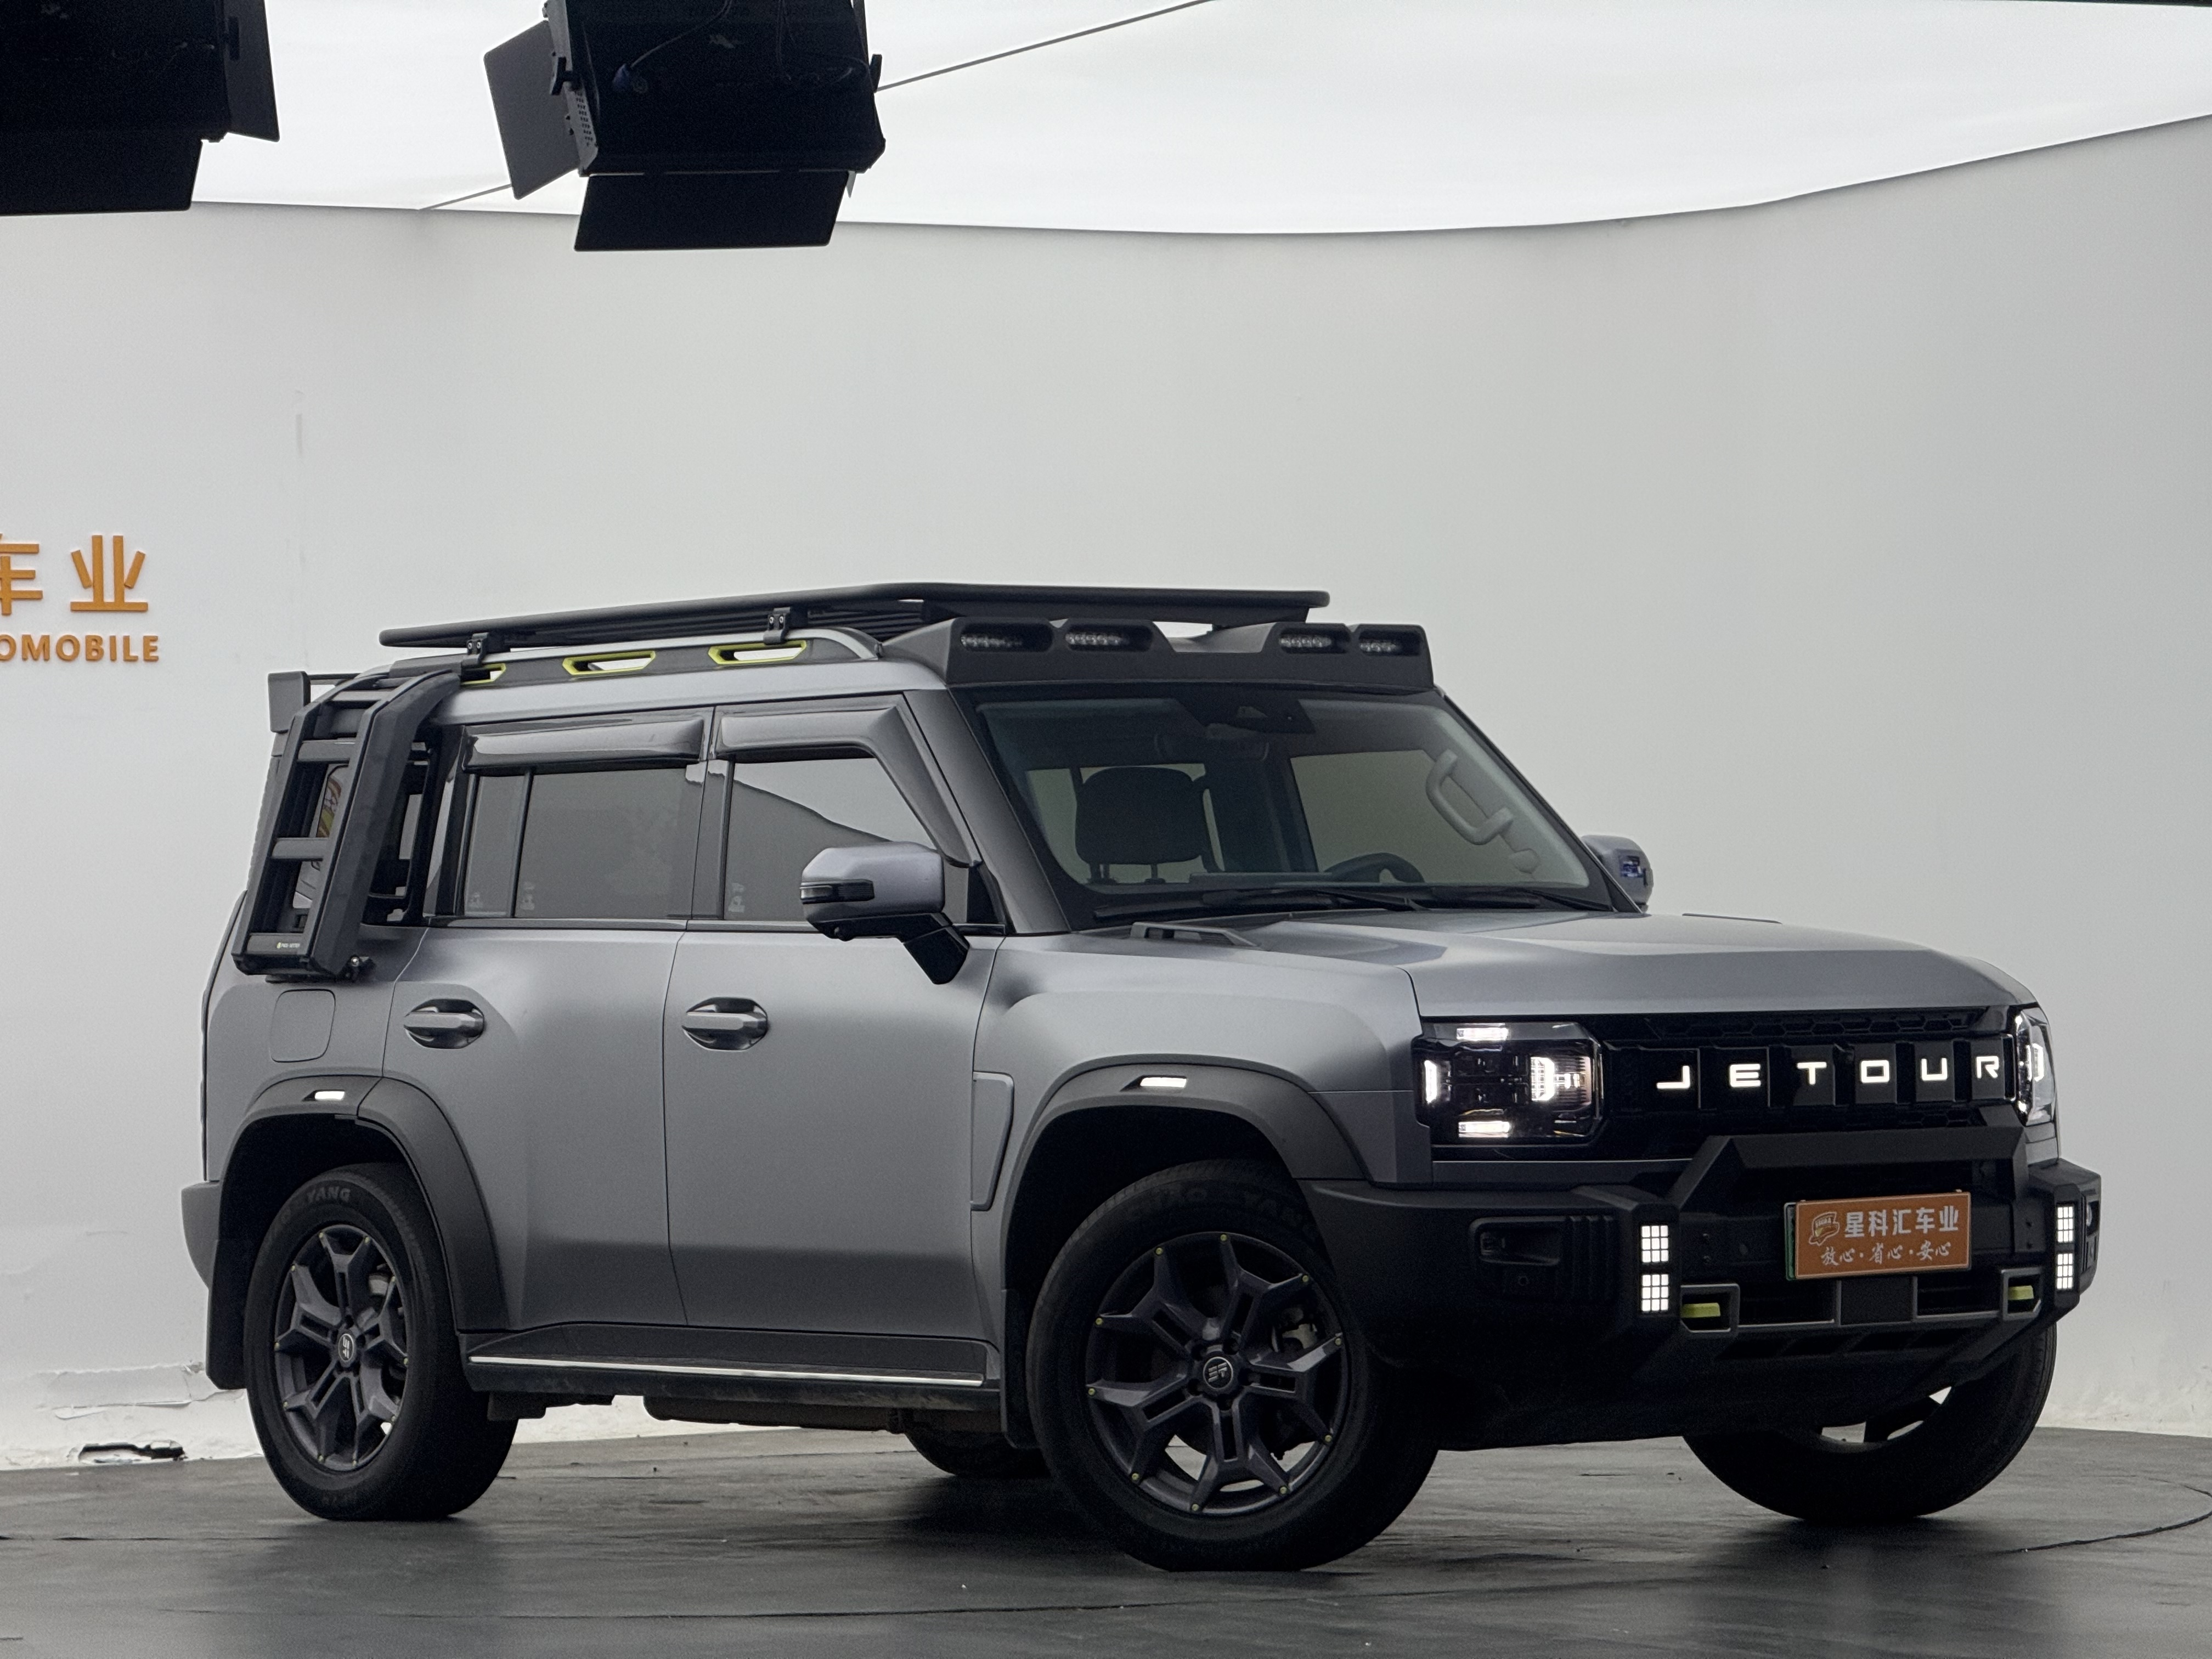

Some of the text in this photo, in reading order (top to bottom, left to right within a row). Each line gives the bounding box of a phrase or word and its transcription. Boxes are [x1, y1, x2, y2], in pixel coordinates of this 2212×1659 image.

[1656, 1055, 2000, 1090] JETOUR
[1844, 1205, 1959, 1238] 星科汇车业
